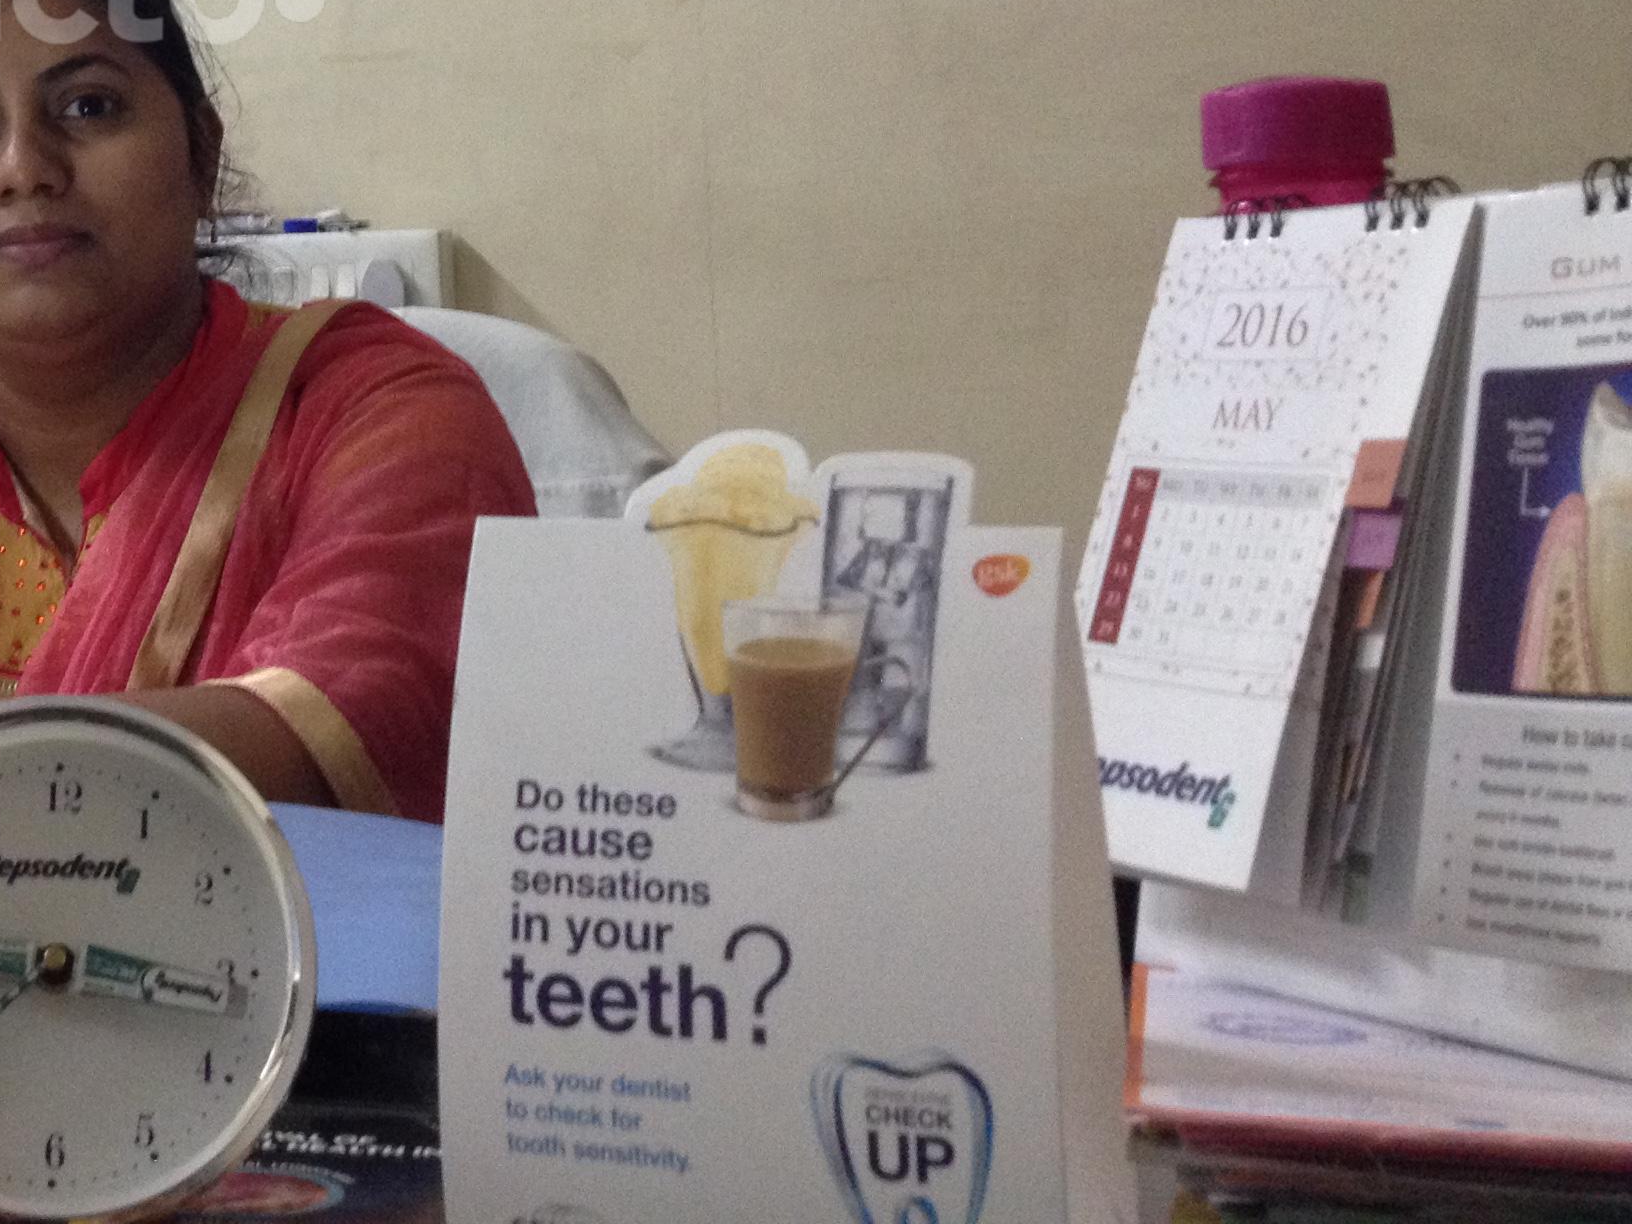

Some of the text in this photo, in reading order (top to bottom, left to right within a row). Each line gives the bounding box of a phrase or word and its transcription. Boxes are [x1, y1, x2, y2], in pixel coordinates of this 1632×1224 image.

[1217, 301, 1310, 349] 2016
[1213, 395, 1285, 432] MAY
[48, 781, 83, 815] 12
[516, 778, 677, 819] Do these
[139, 808, 149, 840] 1
[514, 823, 654, 861] cause
[194, 872, 214, 905] 2
[511, 868, 711, 906] sensations
[511, 900, 673, 956] in your
[505, 1062, 691, 1103] Ask your dentist
[134, 1112, 155, 1147] 5
[506, 1096, 642, 1131] to check for
[866, 1104, 952, 1129] CHECK
[45, 1132, 65, 1167] 6
[507, 1131, 566, 1156] tooth
[868, 1130, 955, 1184] UP
